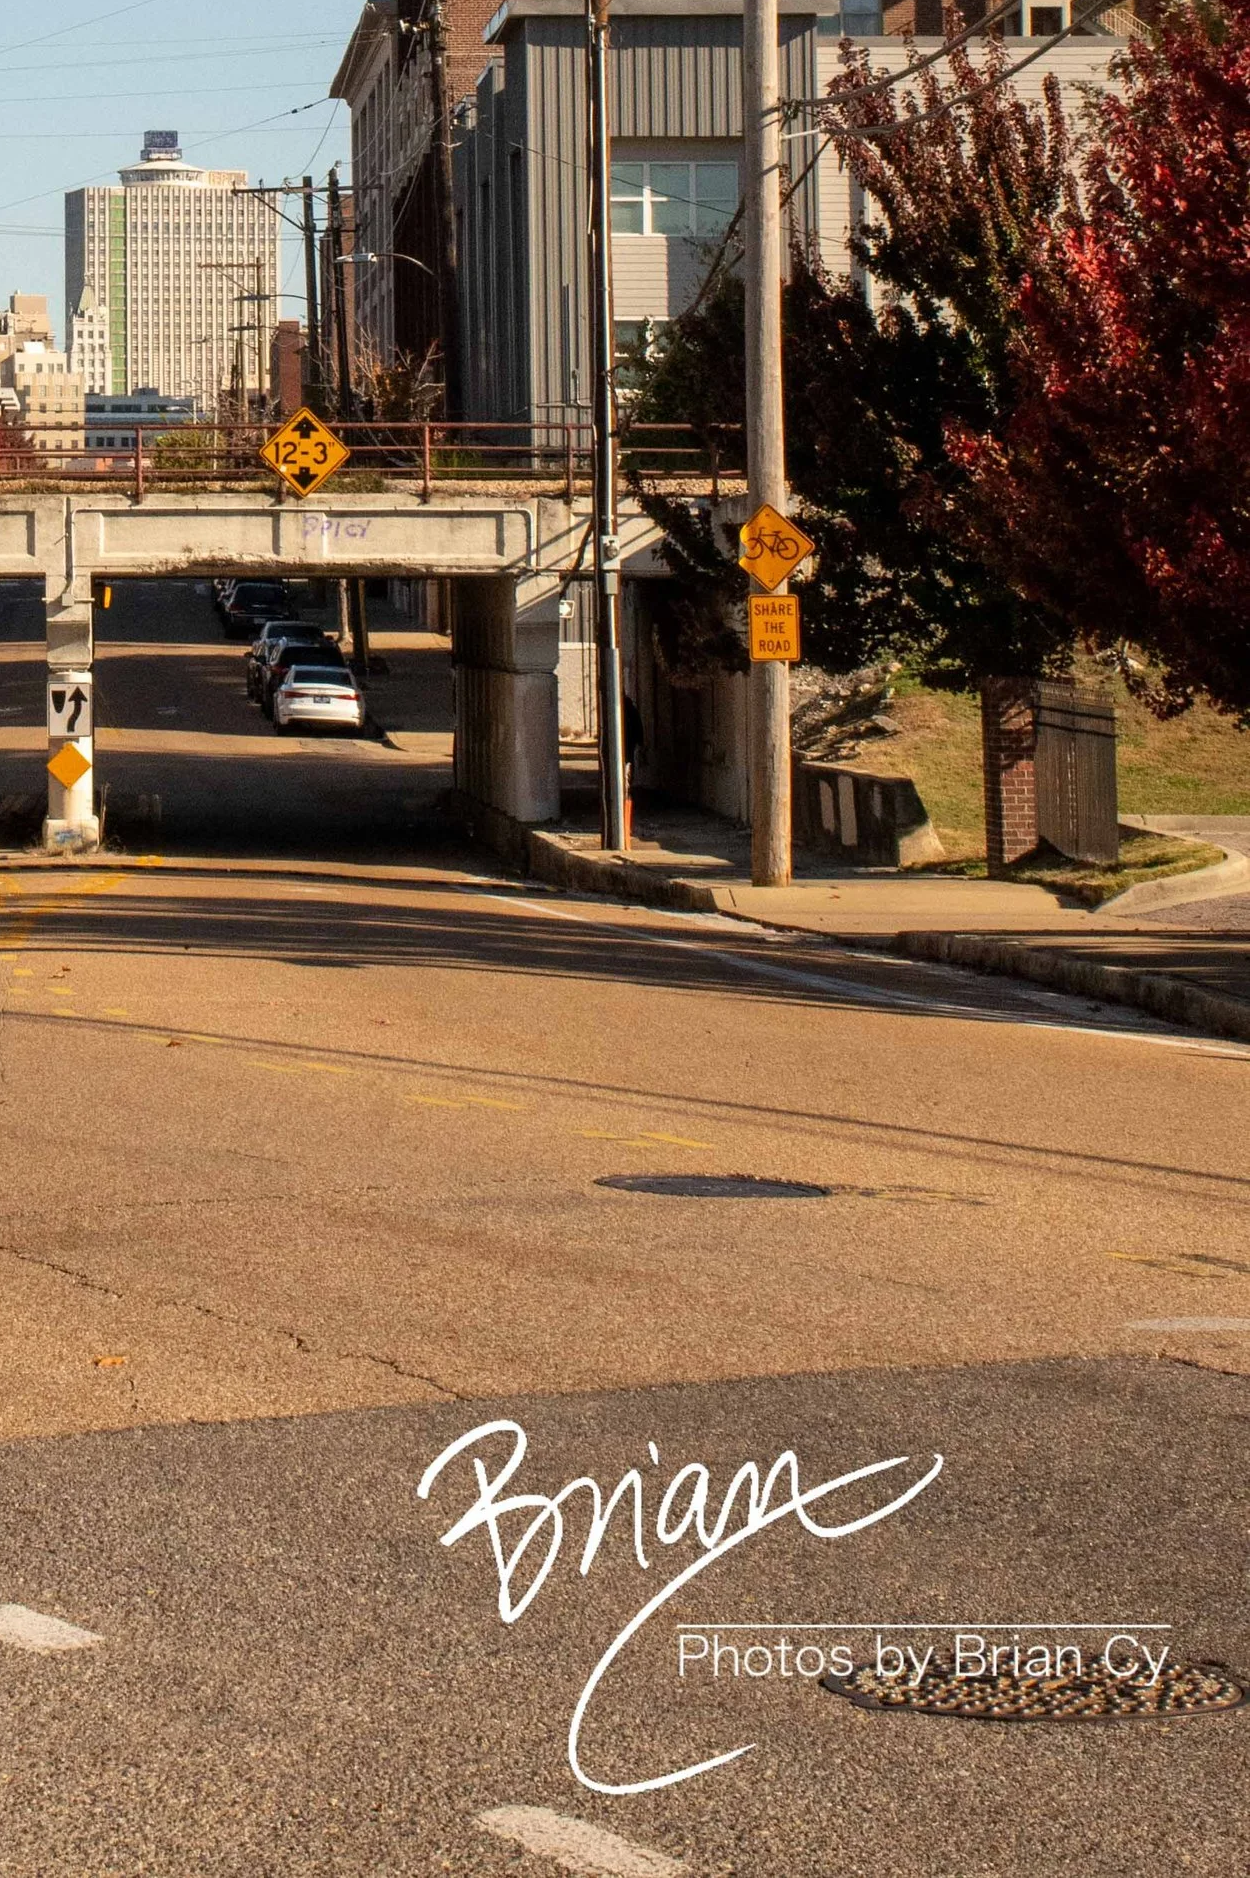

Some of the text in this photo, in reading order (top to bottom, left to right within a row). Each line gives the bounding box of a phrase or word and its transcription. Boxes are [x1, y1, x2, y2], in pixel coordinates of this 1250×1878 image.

[754, 603, 793, 616] SHARE
[763, 621, 786, 634] THE
[759, 639, 791, 652] ROAD
